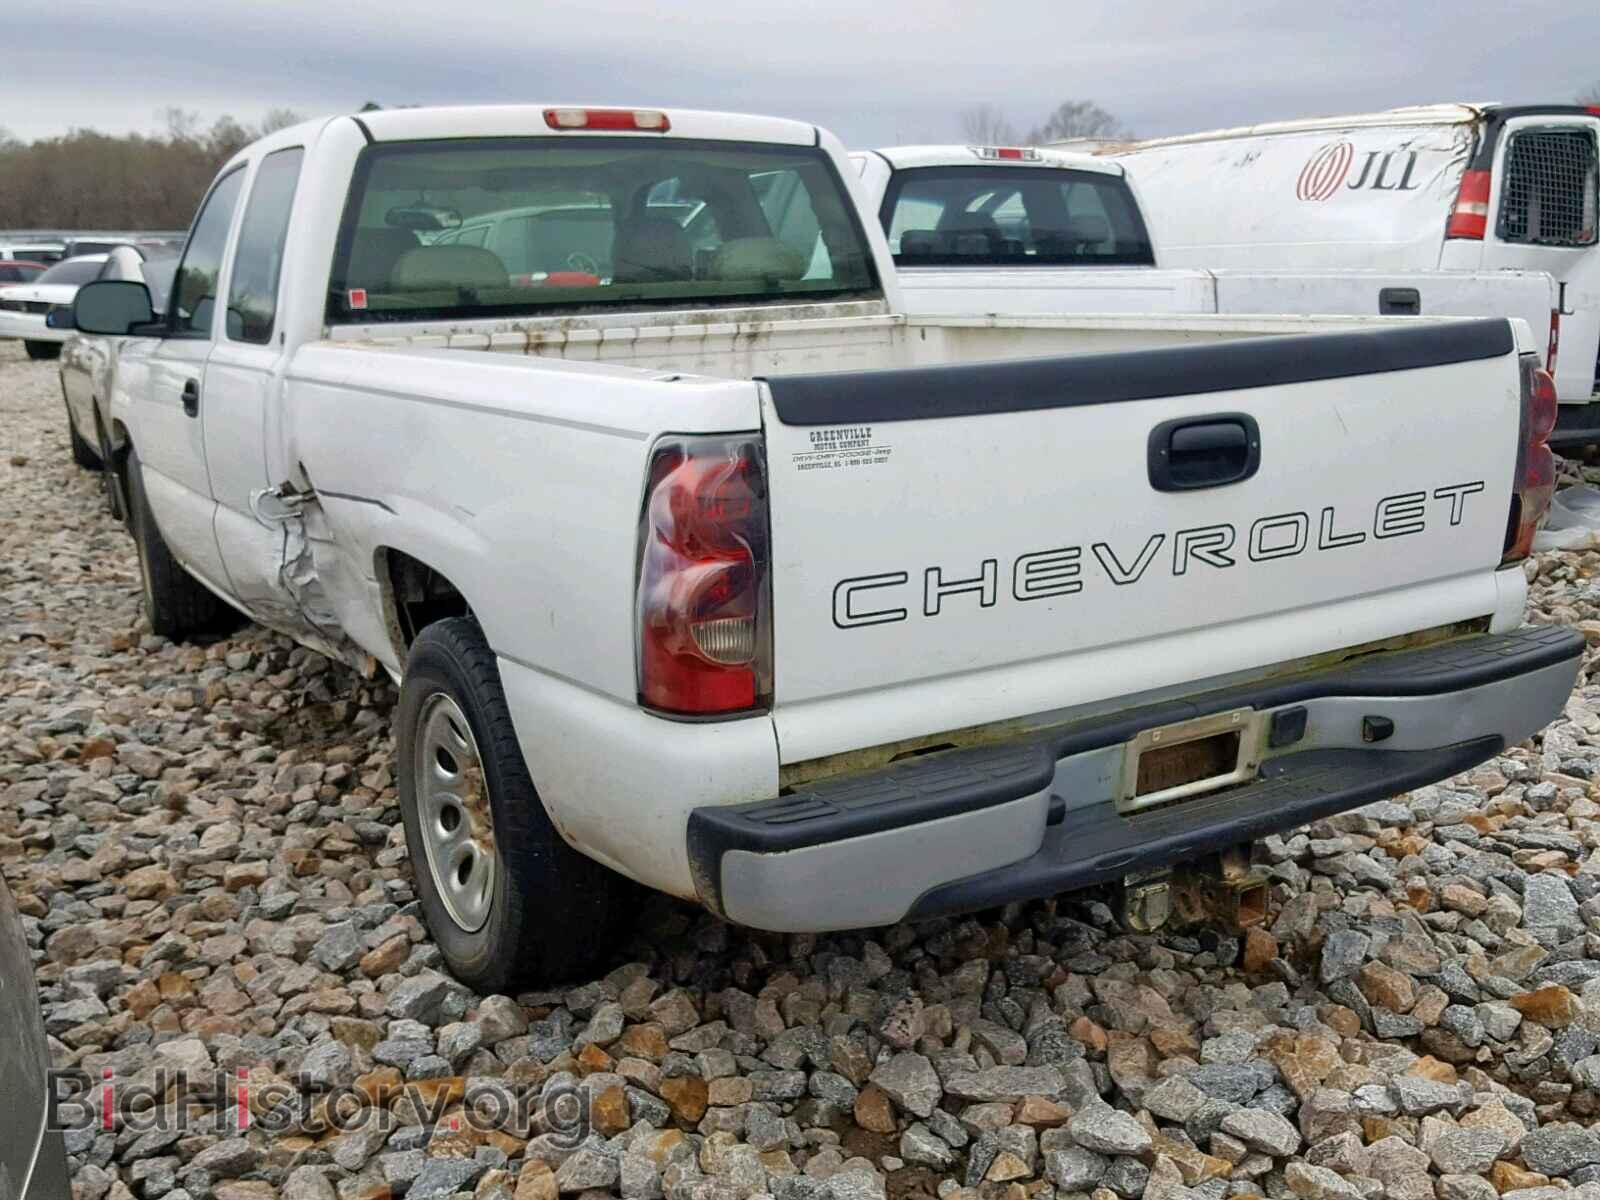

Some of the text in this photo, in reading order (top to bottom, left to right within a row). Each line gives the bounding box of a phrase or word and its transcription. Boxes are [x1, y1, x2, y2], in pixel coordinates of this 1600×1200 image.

[1346, 150, 1420, 190] JLL
[809, 427, 872, 442] GREENVILLE
[840, 439, 870, 449] COMPANY
[832, 481, 1485, 630] CHEVROLET
